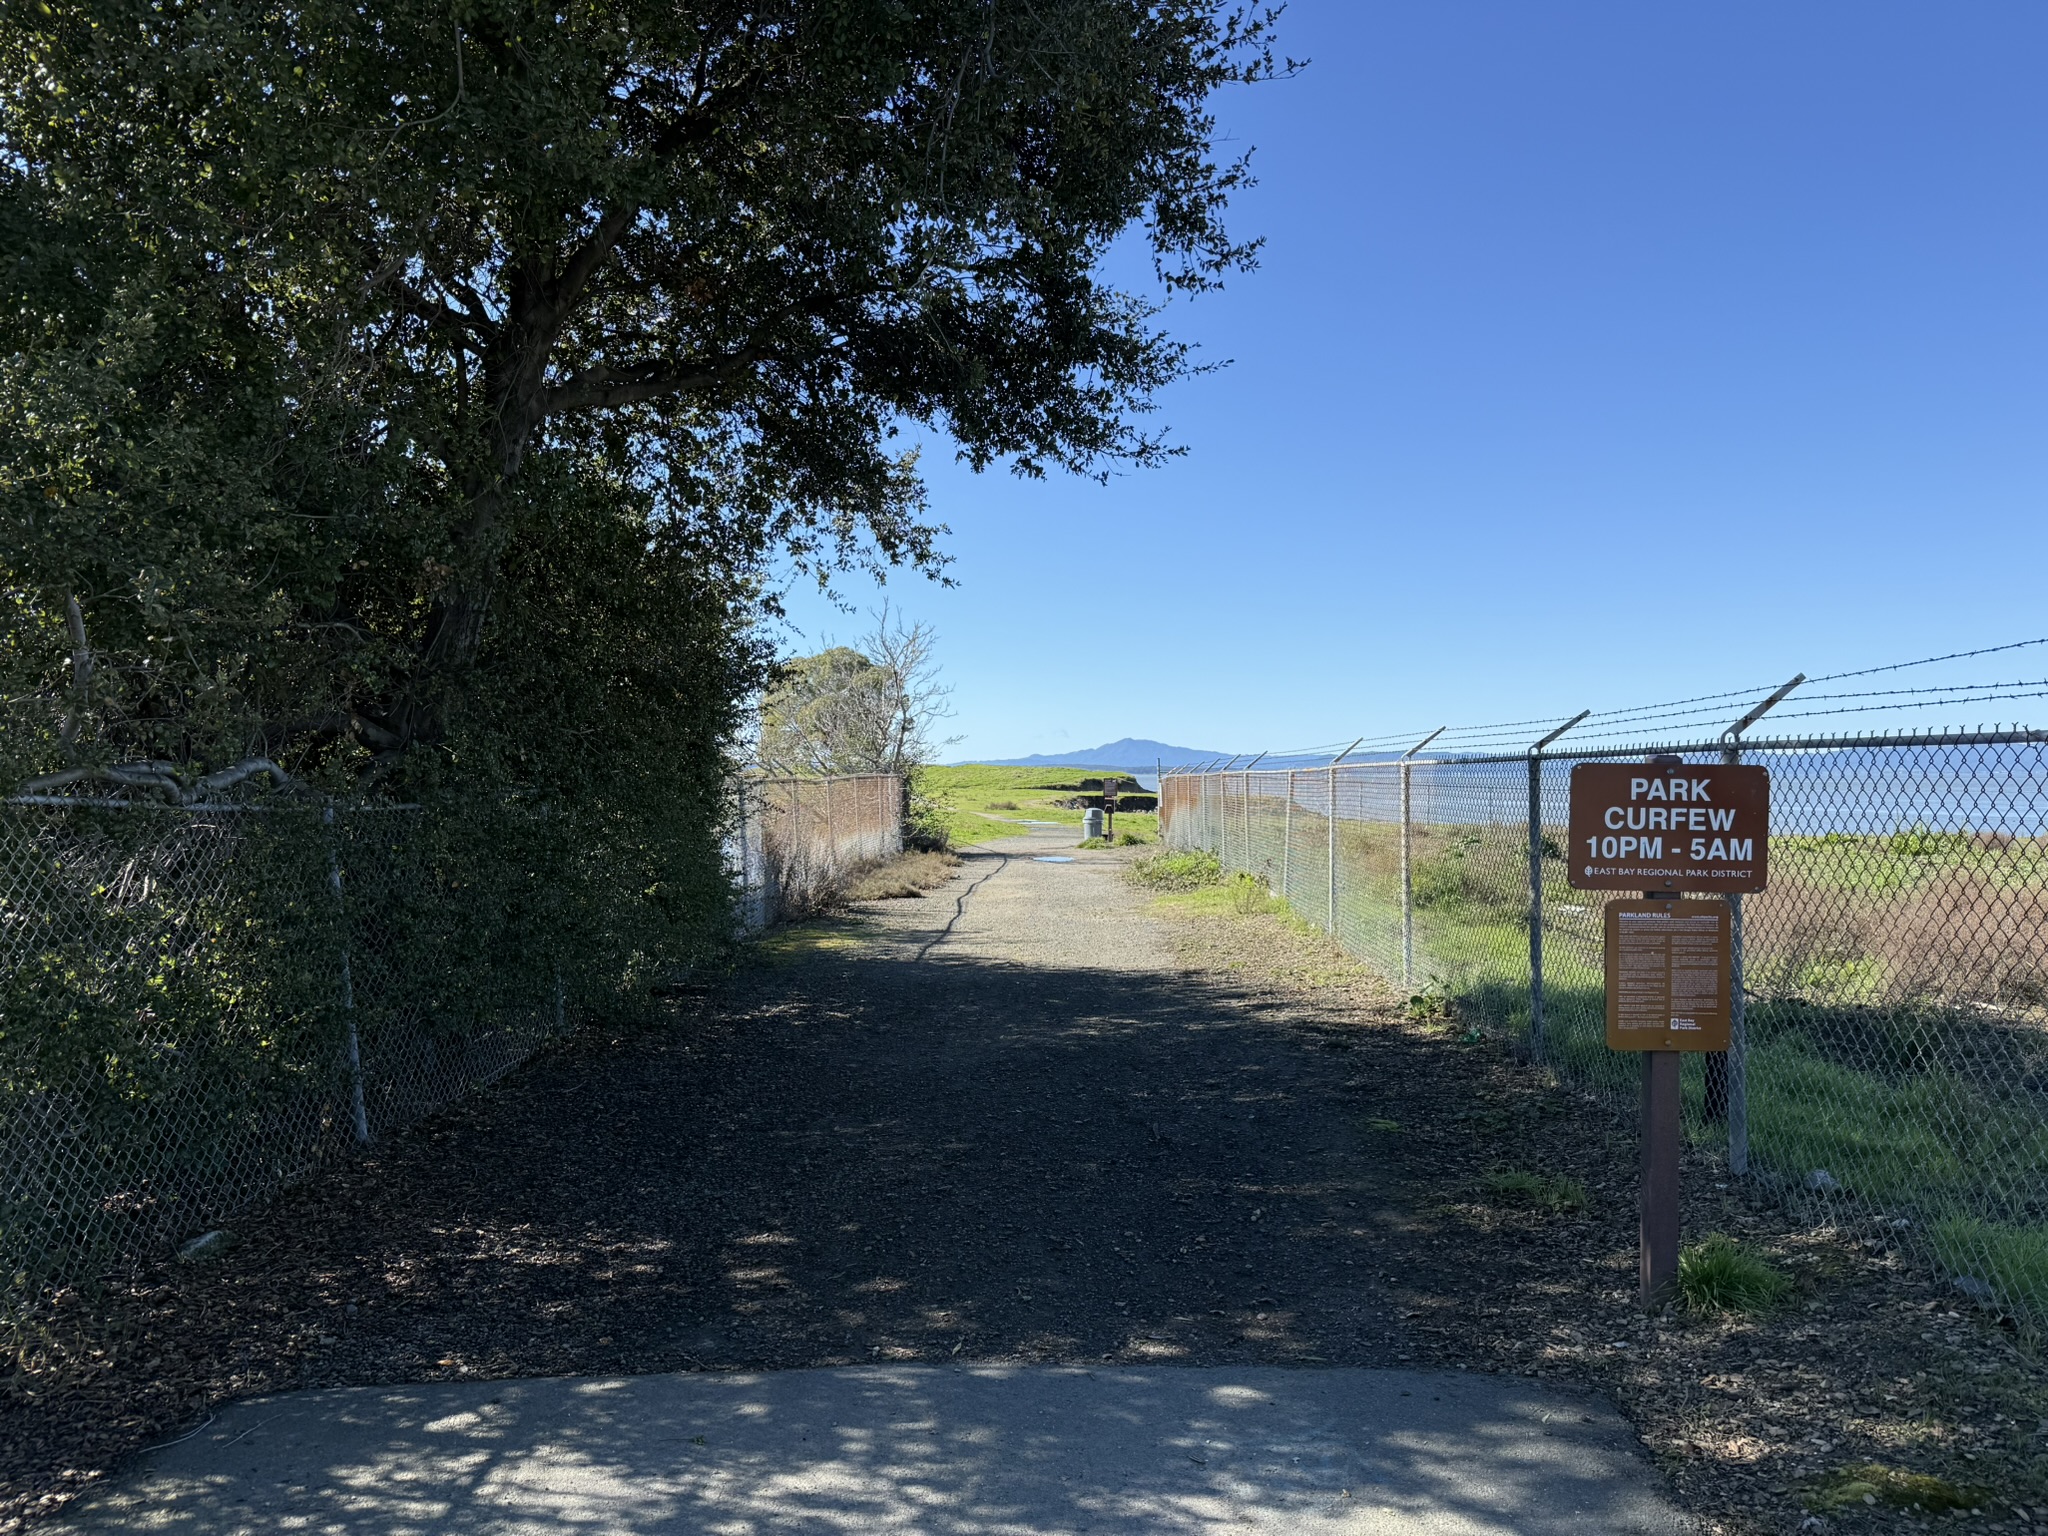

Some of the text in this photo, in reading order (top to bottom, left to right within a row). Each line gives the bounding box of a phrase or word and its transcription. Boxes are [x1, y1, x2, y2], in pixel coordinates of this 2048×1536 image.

[1631, 778, 1711, 801] PARK
[1605, 807, 1736, 831] CURFEW
[1586, 836, 1662, 859] 10PM
[1690, 838, 1752, 861] 5AM
[1594, 867, 1752, 878] EAST BAY REGIONAL PARK DISTRICT
